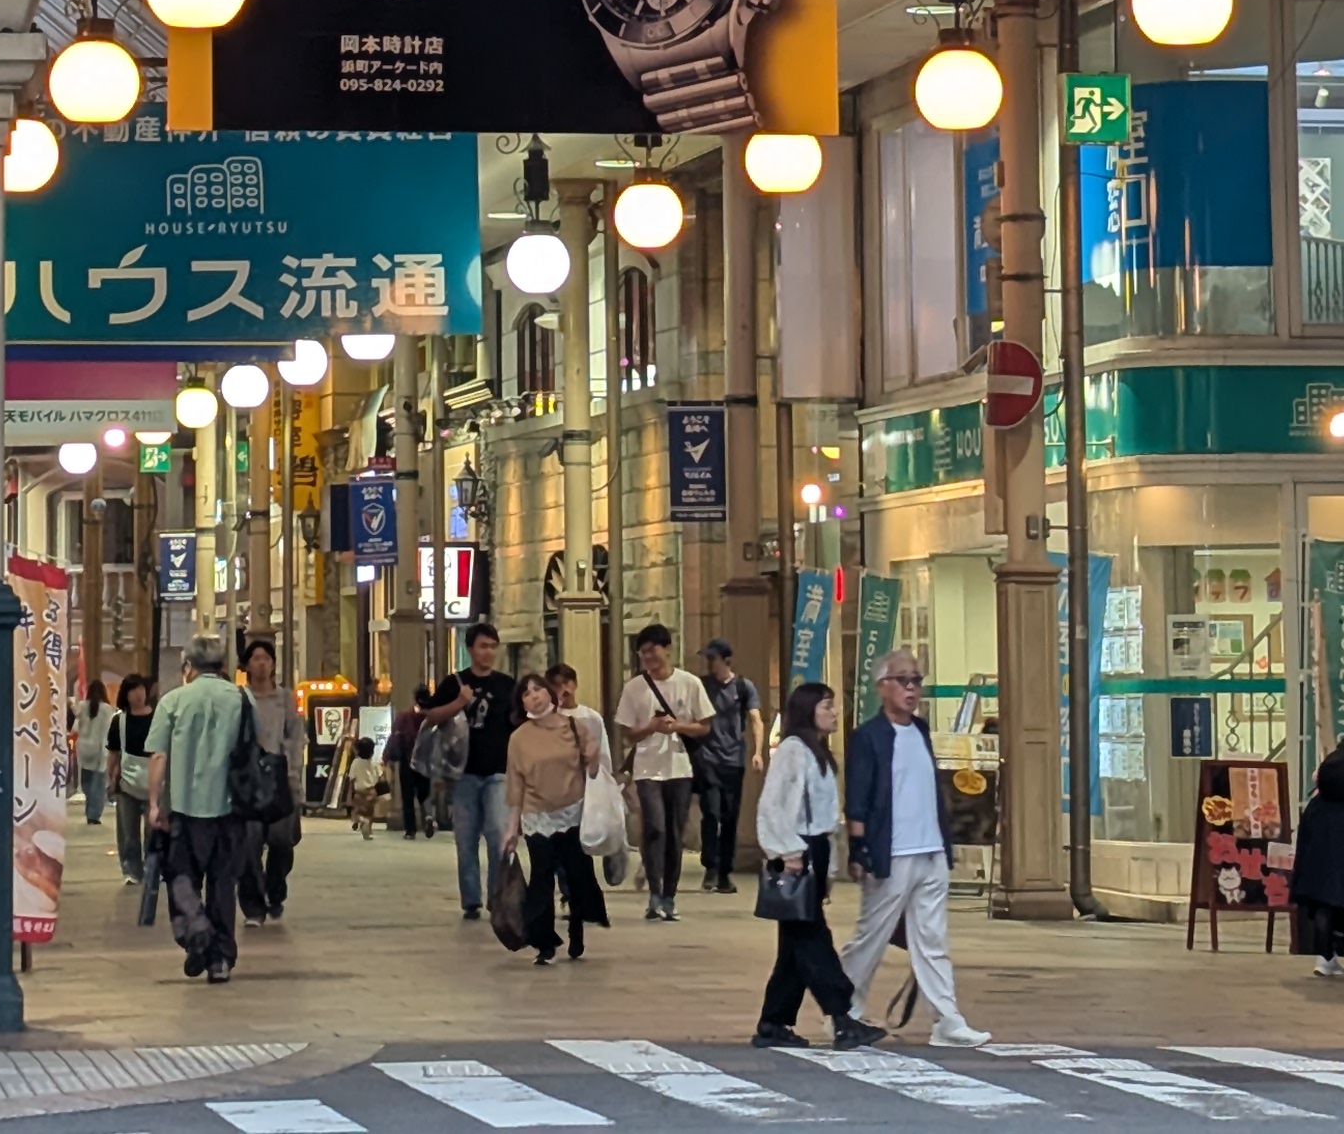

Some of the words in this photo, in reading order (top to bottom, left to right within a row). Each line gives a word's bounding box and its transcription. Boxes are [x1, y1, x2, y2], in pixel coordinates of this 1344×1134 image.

[340, 34, 444, 55] 岡本時計店
[339, 78, 444, 93] 095-824-0292
[145, 222, 207, 235] HOUSE
[217, 221, 289, 235] RYUTSU
[5, 244, 449, 325] ハウス流通
[422, 600, 461, 616] KC
[14, 601, 41, 825] キャンペーン
